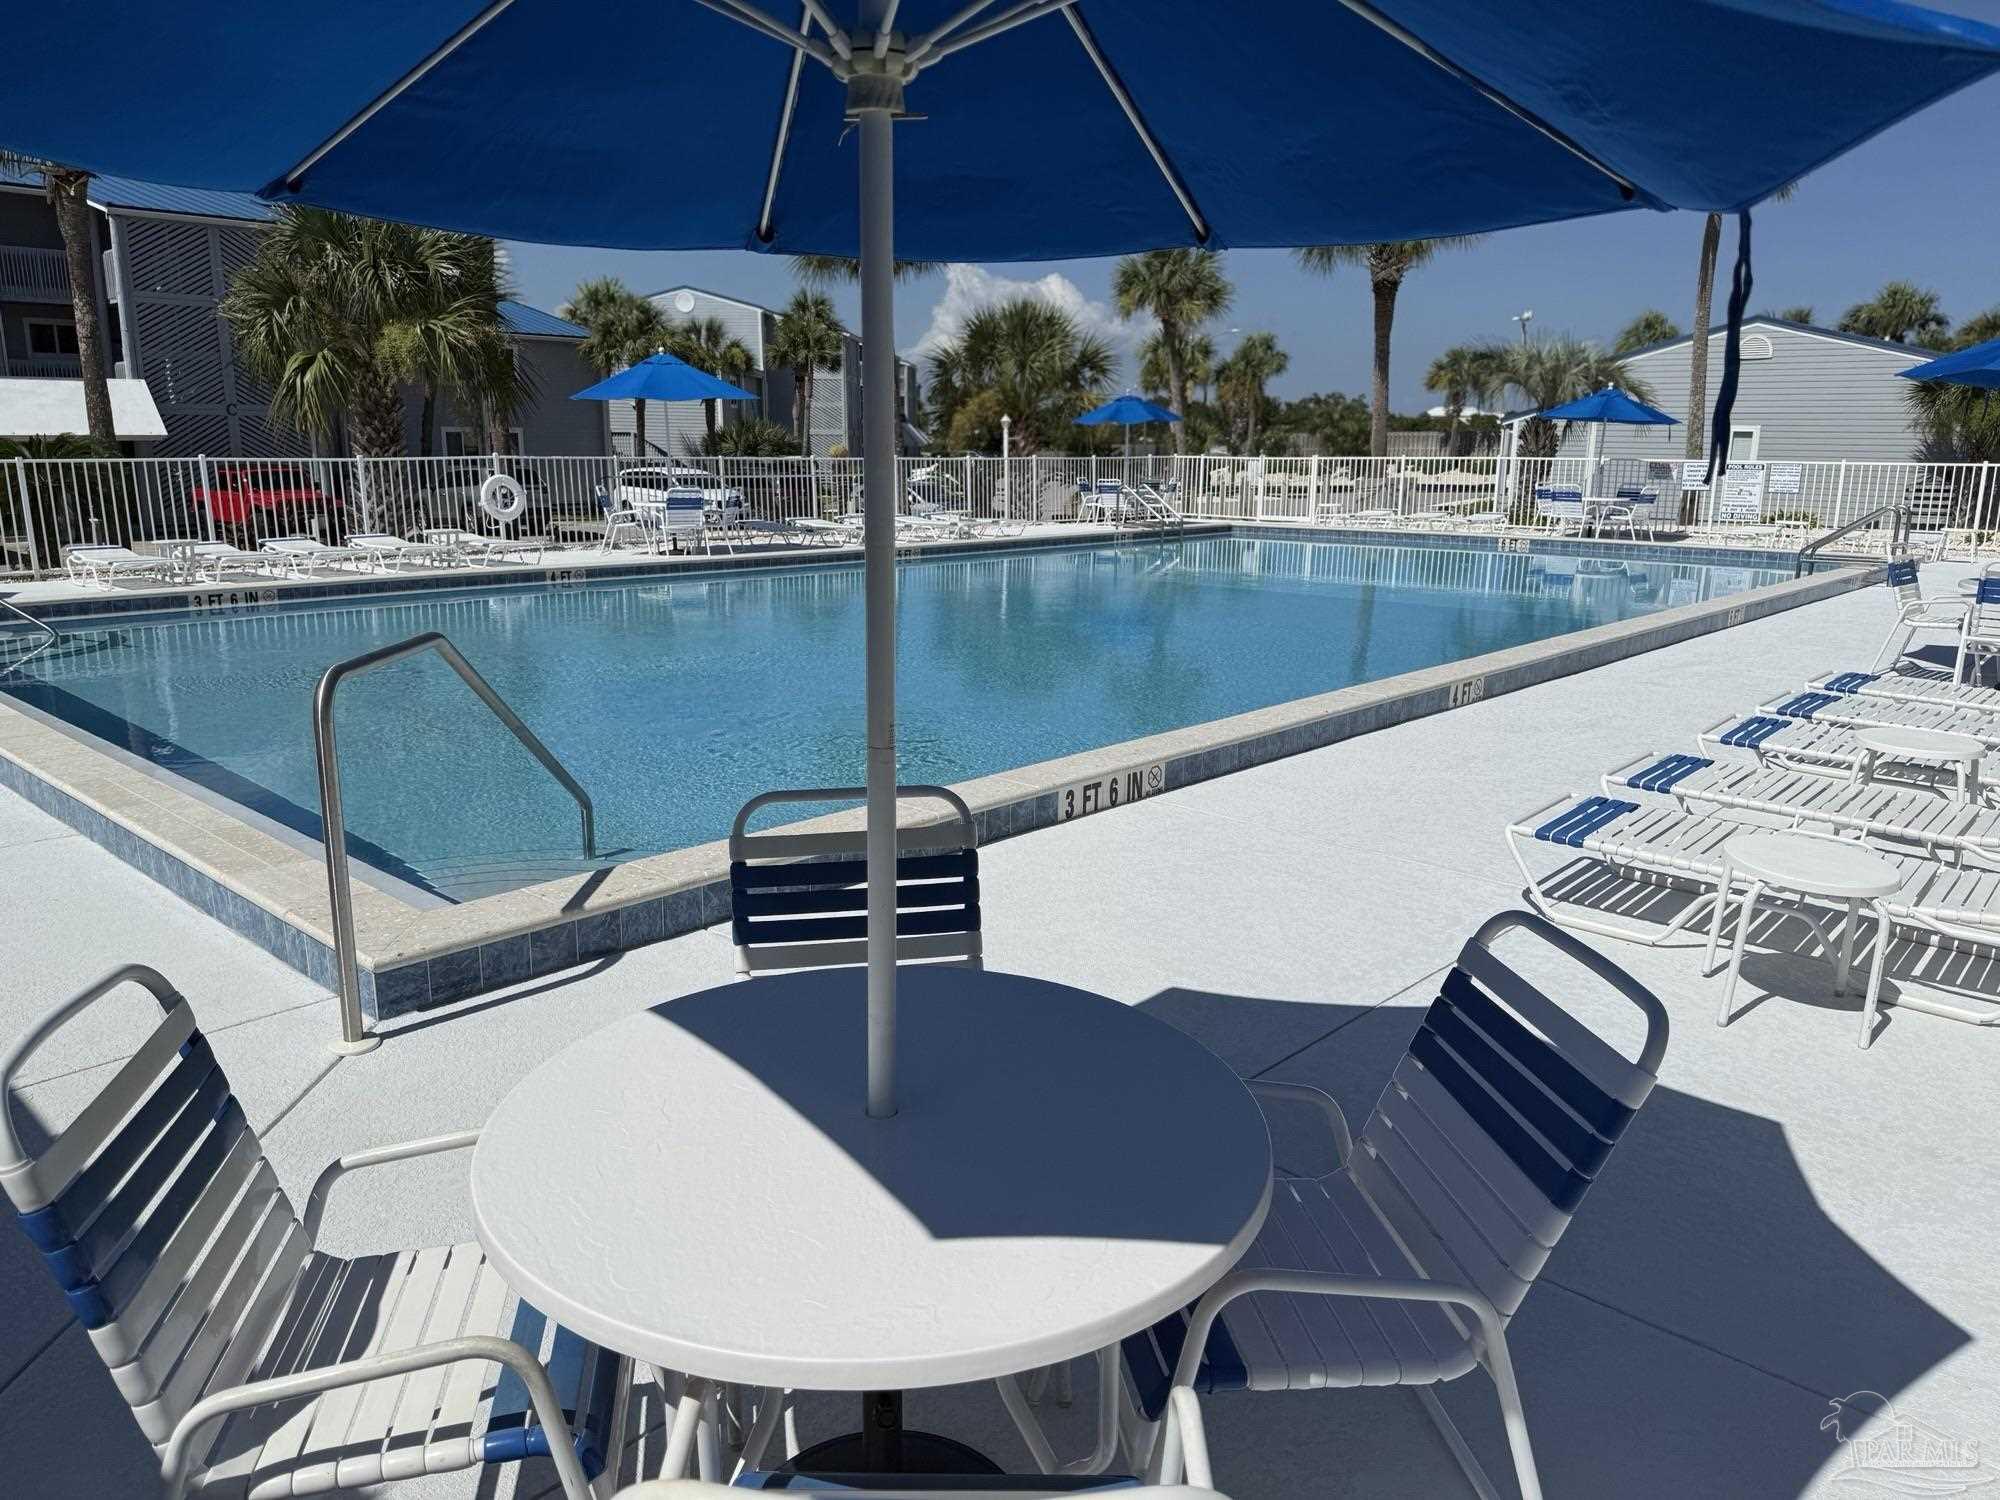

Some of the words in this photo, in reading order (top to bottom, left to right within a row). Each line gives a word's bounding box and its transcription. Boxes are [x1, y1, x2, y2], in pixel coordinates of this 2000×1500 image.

[550, 570, 556, 582] 4
[560, 570, 572, 581] FT
[194, 595, 202, 608] 3
[208, 593, 223, 606] FT
[230, 593, 238, 605] 6
[244, 591, 258, 603] IN
[1452, 684, 1459, 706] 4
[1461, 680, 1473, 704] FT
[1065, 789, 1074, 819] 3
[1082, 781, 1102, 814] FT
[1109, 777, 1119, 806] 6
[1127, 770, 1143, 802] IN
